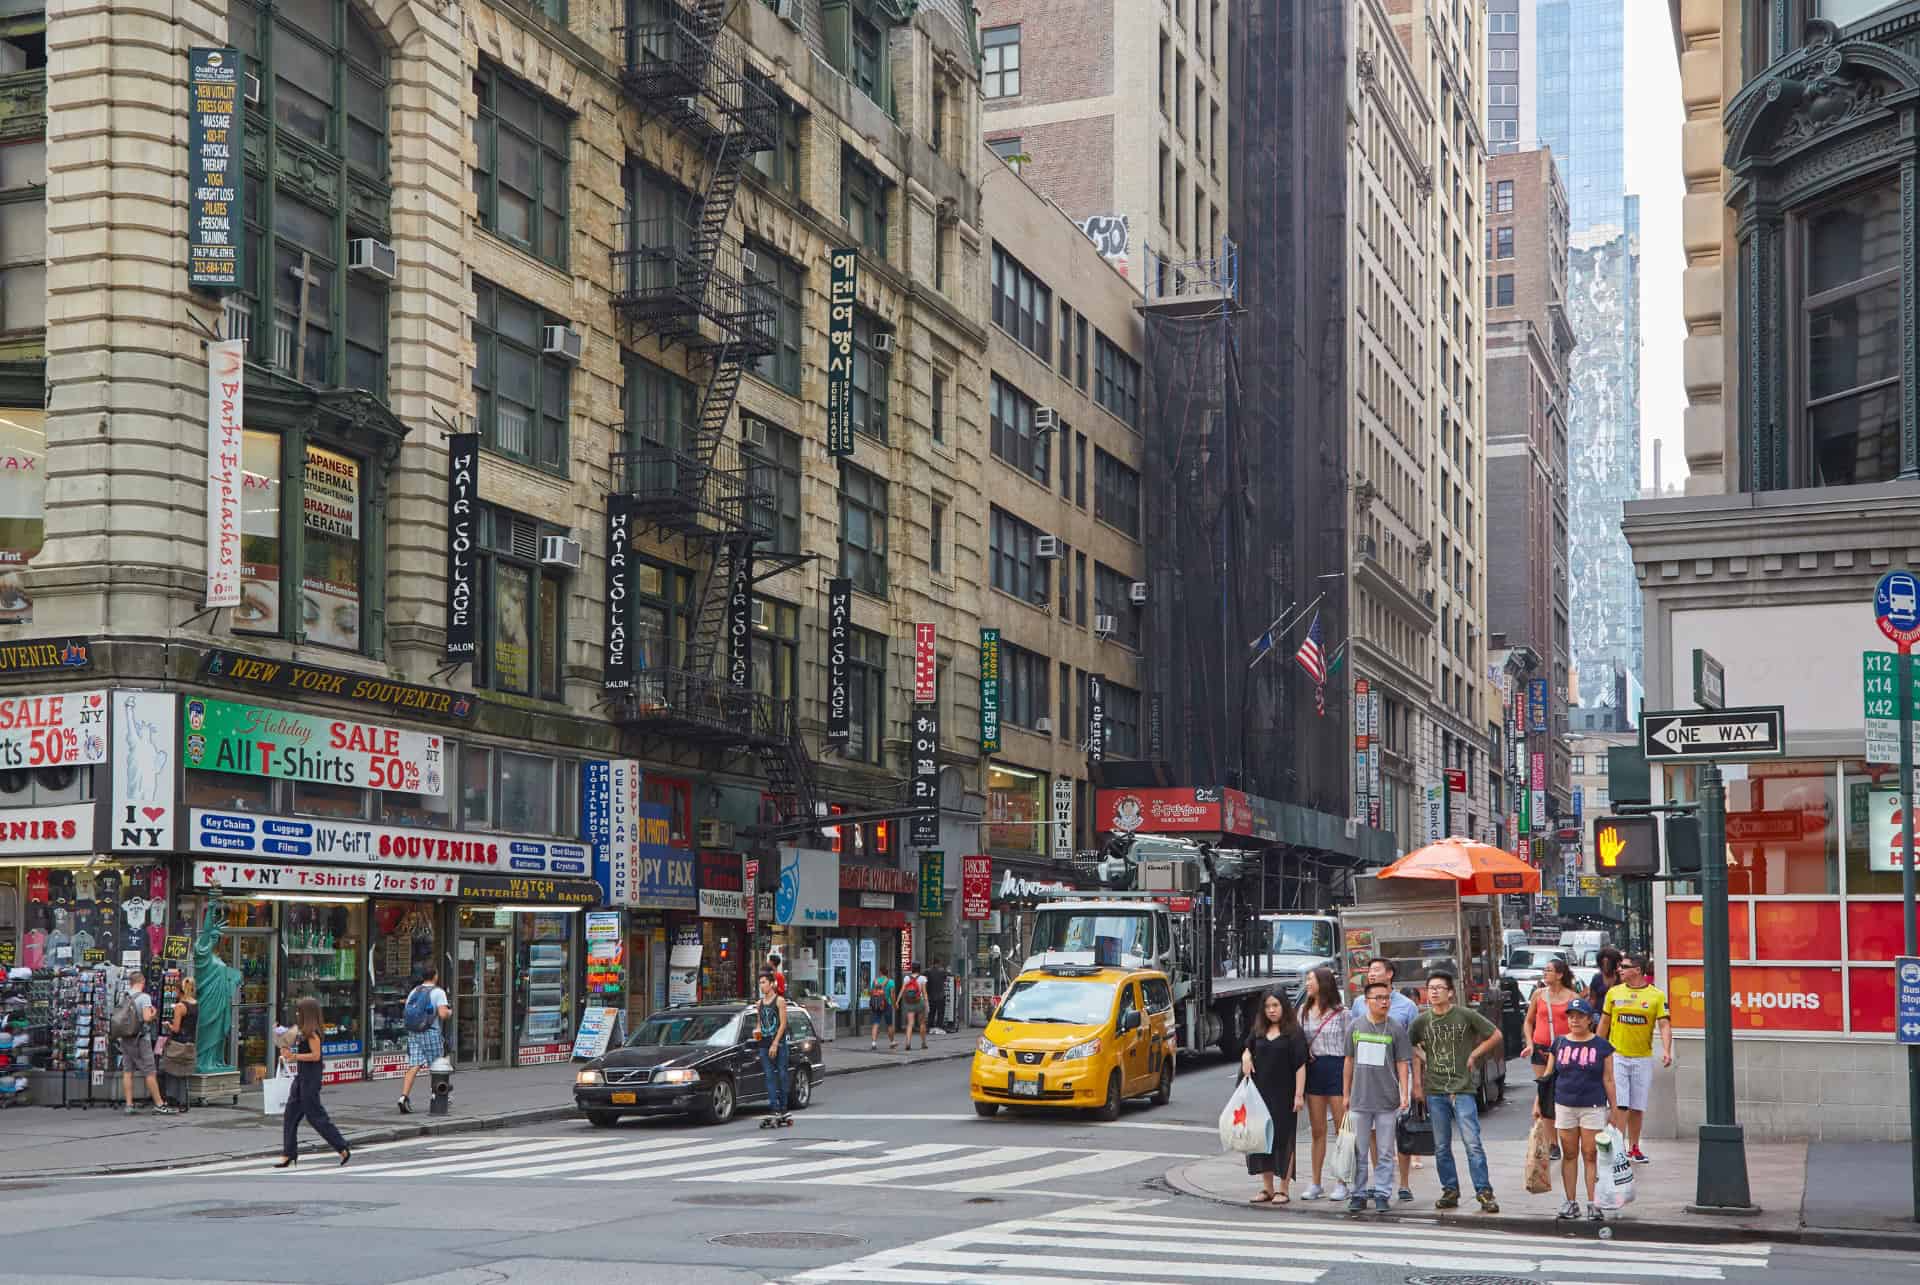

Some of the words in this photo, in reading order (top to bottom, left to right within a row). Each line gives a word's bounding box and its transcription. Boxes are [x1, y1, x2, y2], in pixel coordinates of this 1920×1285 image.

[195, 65, 218, 75] Quality
[218, 66, 234, 74] Care
[198, 85, 211, 98] NEW
[211, 86, 235, 98] VITALITY
[197, 100, 218, 113] STRESS
[203, 114, 230, 128] MASSAGE
[203, 143, 230, 157] PHYSICAL
[202, 158, 227, 171] THERAPY
[207, 173, 224, 186] YOGA
[198, 187, 219, 201] WEIGHT
[220, 188, 234, 201] LOSS
[204, 202, 227, 215] PILATES
[201, 216, 230, 230] PERSONAL
[201, 231, 228, 244] TRAINING
[220, 381, 241, 446] Barbi
[243, 477, 271, 490] AX
[305, 467, 354, 492] THERMAL
[454, 454, 471, 514] HAIR
[209, 453, 239, 566] Eyelashes
[304, 497, 353, 522] BRAZILIAN
[304, 512, 353, 537] KERATIN
[611, 514, 626, 567] HAIR
[240, 566, 257, 576] int
[453, 522, 470, 625] COLLAGE
[610, 574, 626, 665] COLLAGE
[832, 594, 846, 638] HAIR
[1883, 620, 1893, 633] NO
[448, 642, 474, 652] SALON
[229, 658, 281, 682] NEW
[288, 668, 347, 694] YORK
[352, 680, 451, 713] SOUVENIR
[605, 680, 629, 689] SALON
[832, 643, 845, 719] COLLAGE
[82, 695, 89, 708] I
[0, 696, 65, 730] SALE
[80, 710, 104, 724] NY
[236, 710, 312, 745] Holiday
[1666, 727, 1701, 744] ONE
[1718, 724, 1759, 741] WAY
[329, 721, 400, 757] SALE
[427, 737, 432, 748] I
[64, 749, 79, 761] OFF
[426, 750, 440, 762] NY
[216, 737, 251, 771] All
[256, 741, 355, 783] T-Shirts
[406, 779, 420, 790] OFF
[630, 764, 638, 816] COPY
[1196, 788, 1213, 801] 2nd
[600, 765, 609, 834] PRINTING
[615, 768, 625, 843] CELLULAR
[1056, 801, 1071, 811] OZ
[125, 805, 137, 823] I
[1430, 803, 1440, 829] Bank
[206, 817, 222, 829] Key
[223, 818, 250, 830] Chains
[272, 823, 304, 836] Luggage
[121, 828, 164, 847] NY
[647, 818, 669, 845] PHOTO
[210, 834, 245, 848] Magnets
[278, 842, 299, 853] Films
[379, 834, 498, 865] SOUVENIRS
[259, 868, 281, 884] NY
[298, 871, 366, 887] T-Shirts
[373, 872, 382, 891] 2
[383, 875, 406, 889] for
[409, 876, 436, 891] $10
[615, 853, 625, 897] PHONE
[639, 858, 662, 885] OPY
[667, 859, 693, 887] FAX
[463, 887, 529, 898] BATTERIES
[510, 879, 555, 894] WATCH
[1903, 985, 1920, 993] Bus
[1730, 992, 1743, 1008] 4
[1747, 992, 1820, 1009] HOURS
[1902, 995, 1920, 1005] Stop
